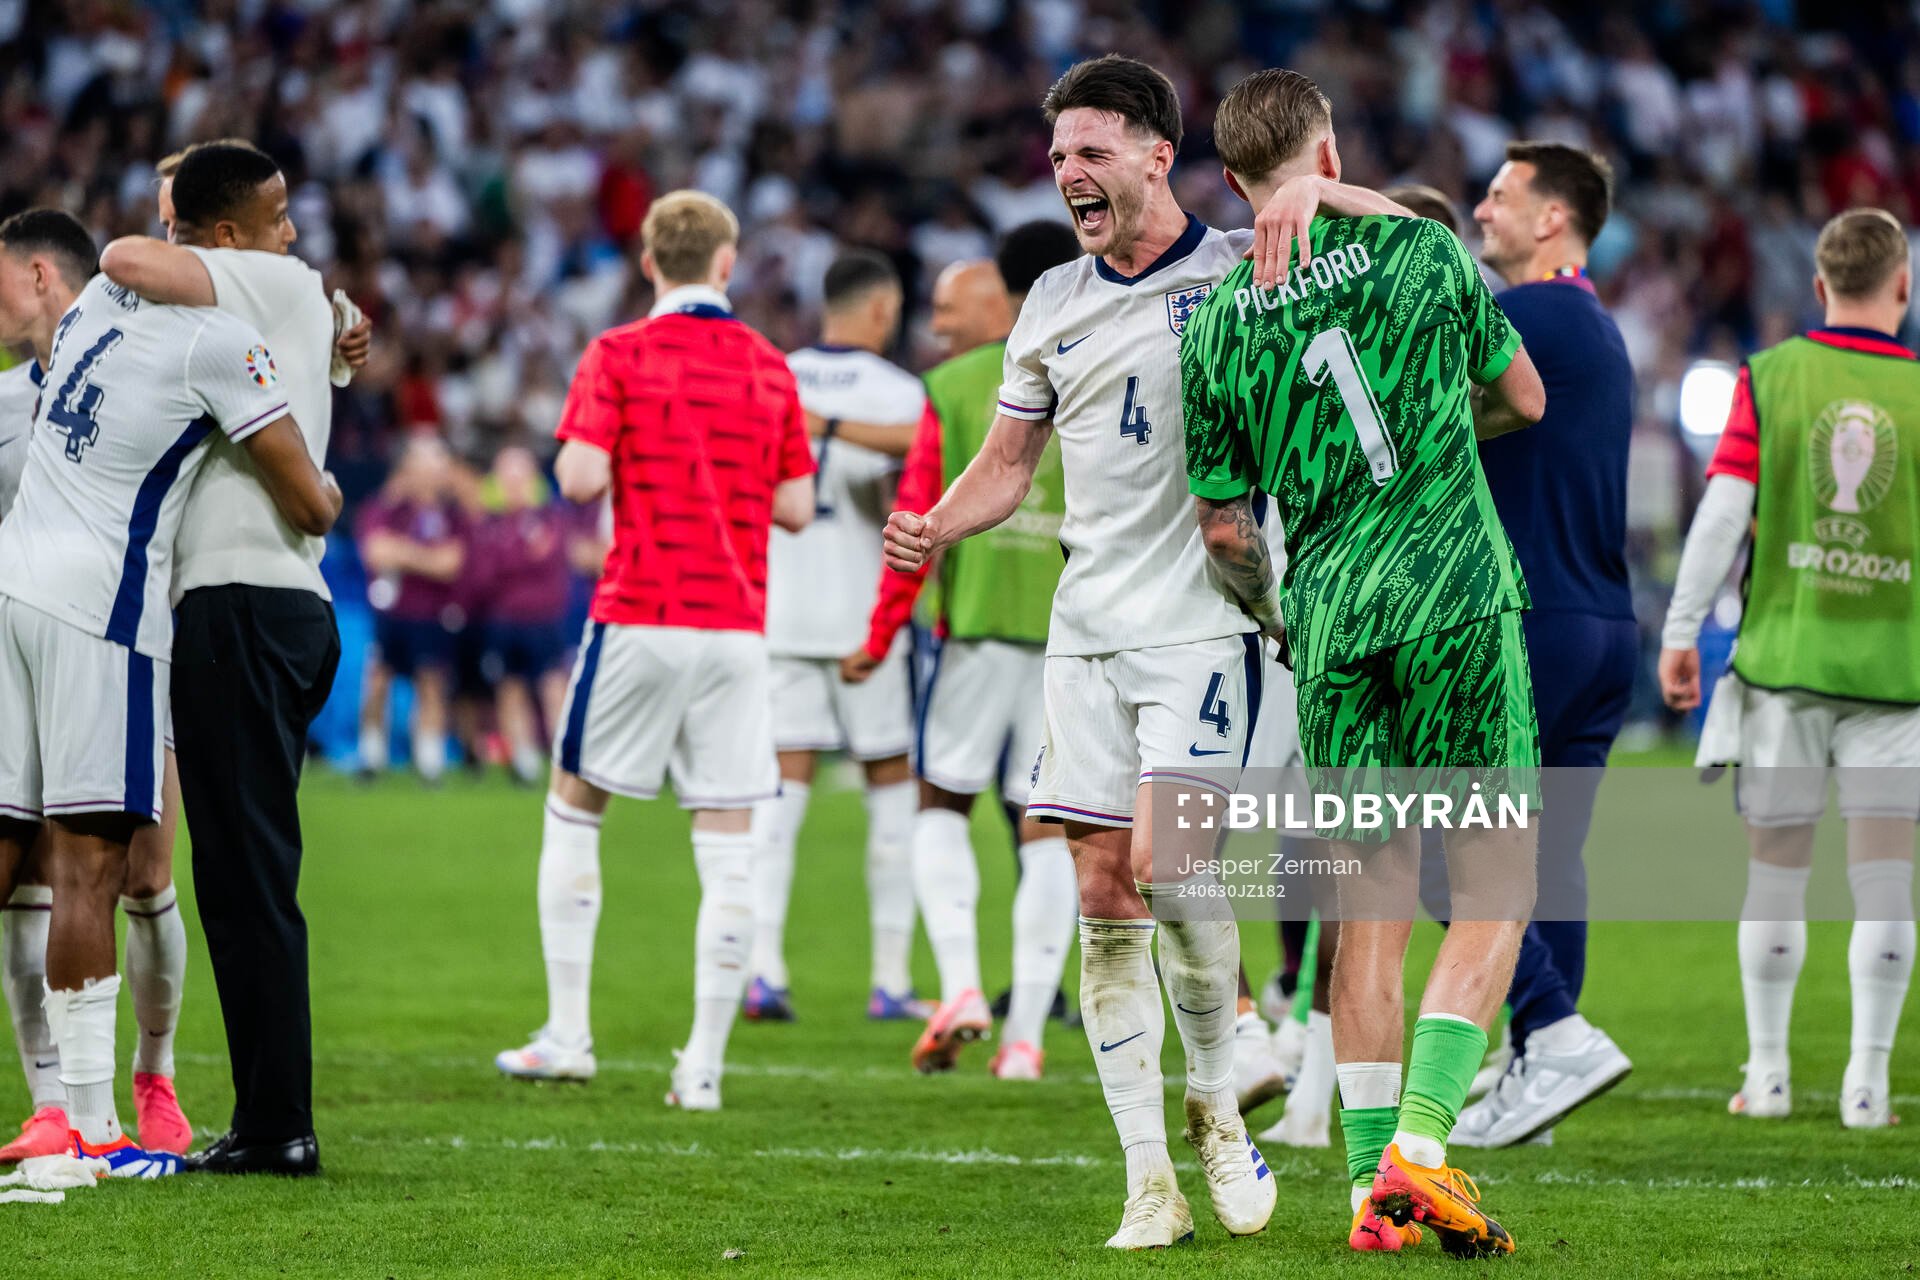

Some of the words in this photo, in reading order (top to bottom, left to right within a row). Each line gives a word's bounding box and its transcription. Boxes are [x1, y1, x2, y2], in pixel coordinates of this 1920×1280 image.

[1234, 243, 1371, 322] PICKFORD
[1120, 376, 1152, 445] 4
[1301, 326, 1399, 487] 1
[1199, 671, 1231, 738] 4
